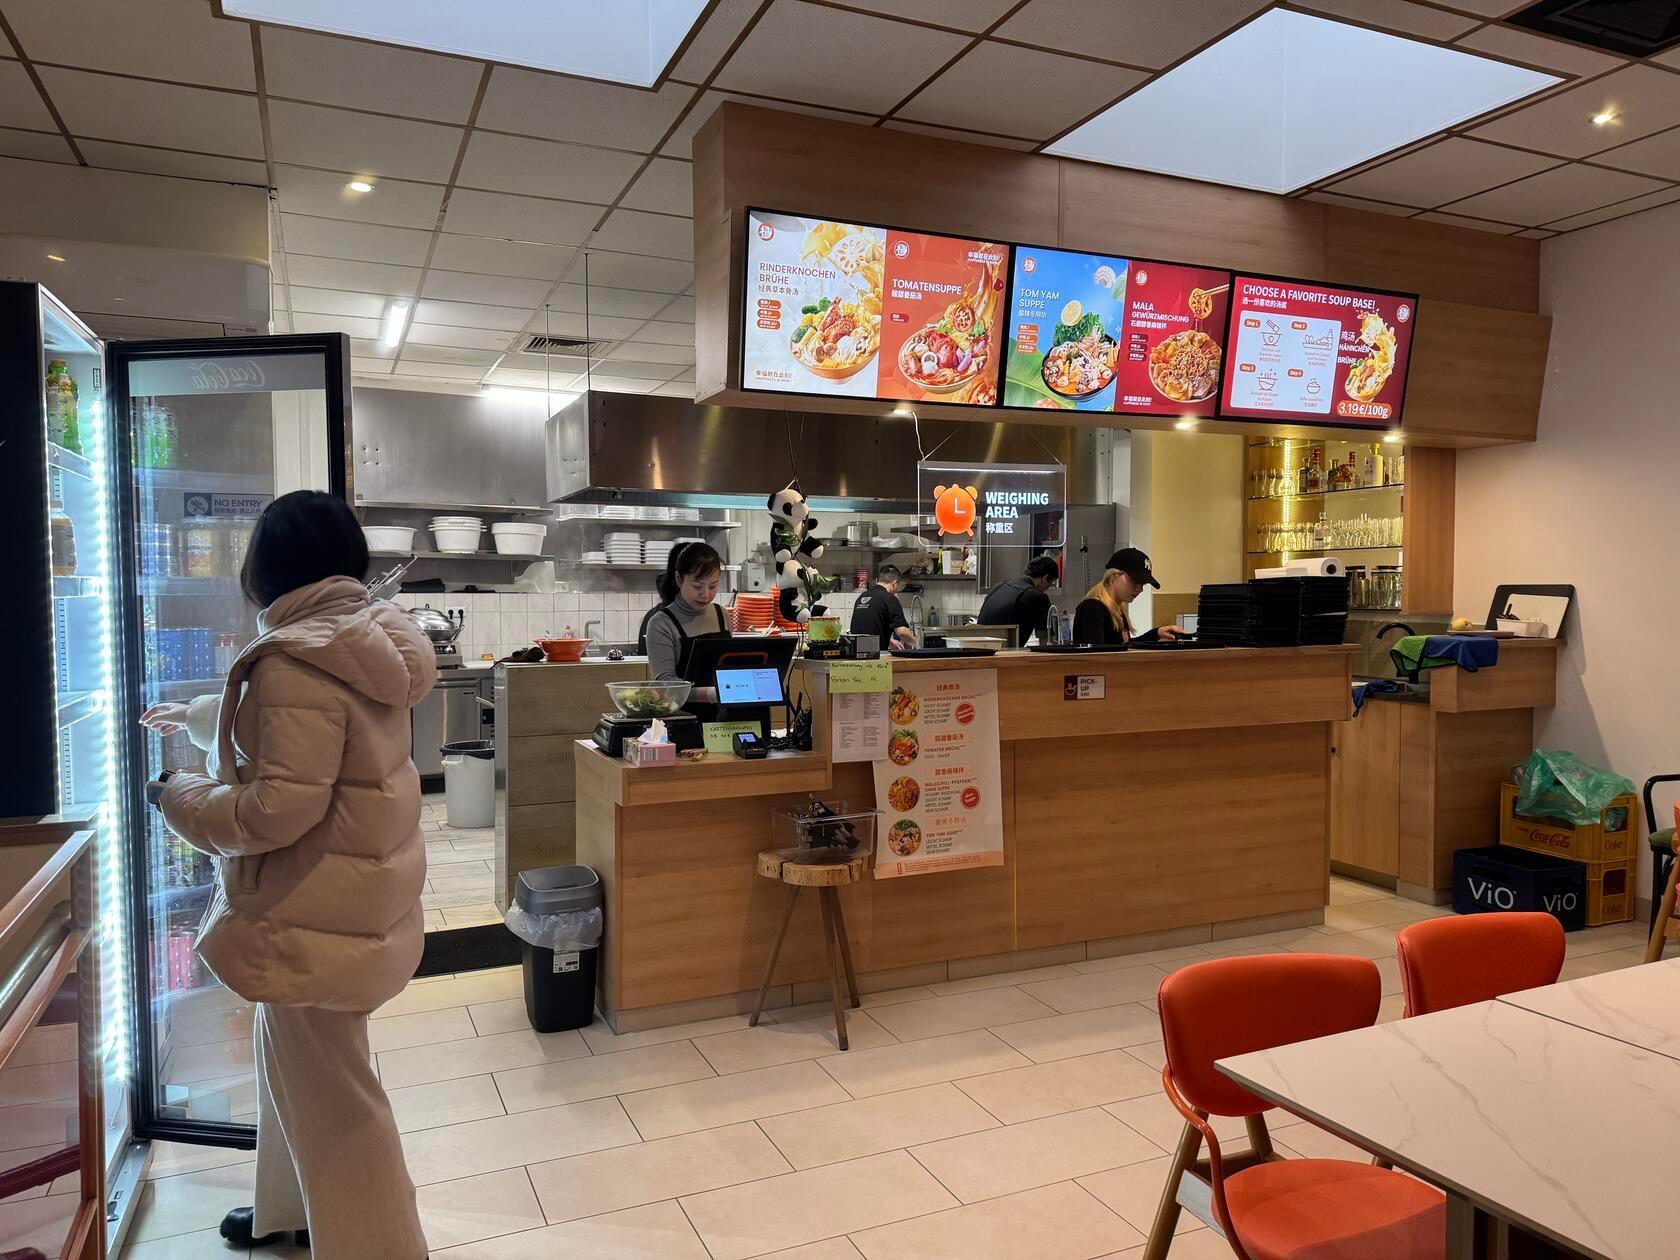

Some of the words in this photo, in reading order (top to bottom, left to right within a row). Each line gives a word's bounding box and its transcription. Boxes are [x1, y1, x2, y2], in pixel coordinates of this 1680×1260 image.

[760, 262, 836, 279] RINDERKNOCHEN
[759, 273, 789, 284] BRÜHE
[892, 278, 962, 295] TOMATENSUPPE
[1020, 288, 1039, 298] TOM
[1041, 290, 1060, 300] YAM
[1243, 284, 1280, 299] CHOOSE
[1280, 289, 1287, 299] A
[1288, 289, 1328, 304] FAVORITE
[1328, 295, 1351, 307] SOUP
[1352, 299, 1376, 310] BASE!
[1019, 298, 1045, 309] SUPPE
[1132, 301, 1154, 310] MALA
[1131, 310, 1189, 323] GEWÜRZMISCHUNG
[214, 499, 229, 507] NO
[231, 499, 262, 507] ENTRY
[985, 491, 1049, 505] WEIGHING
[985, 506, 1018, 518] AREA
[985, 522, 1013, 533] 称重区
[1604, 840, 1624, 849] Coke
[1467, 877, 1514, 909] ViO
[1543, 893, 1577, 912] ViO
